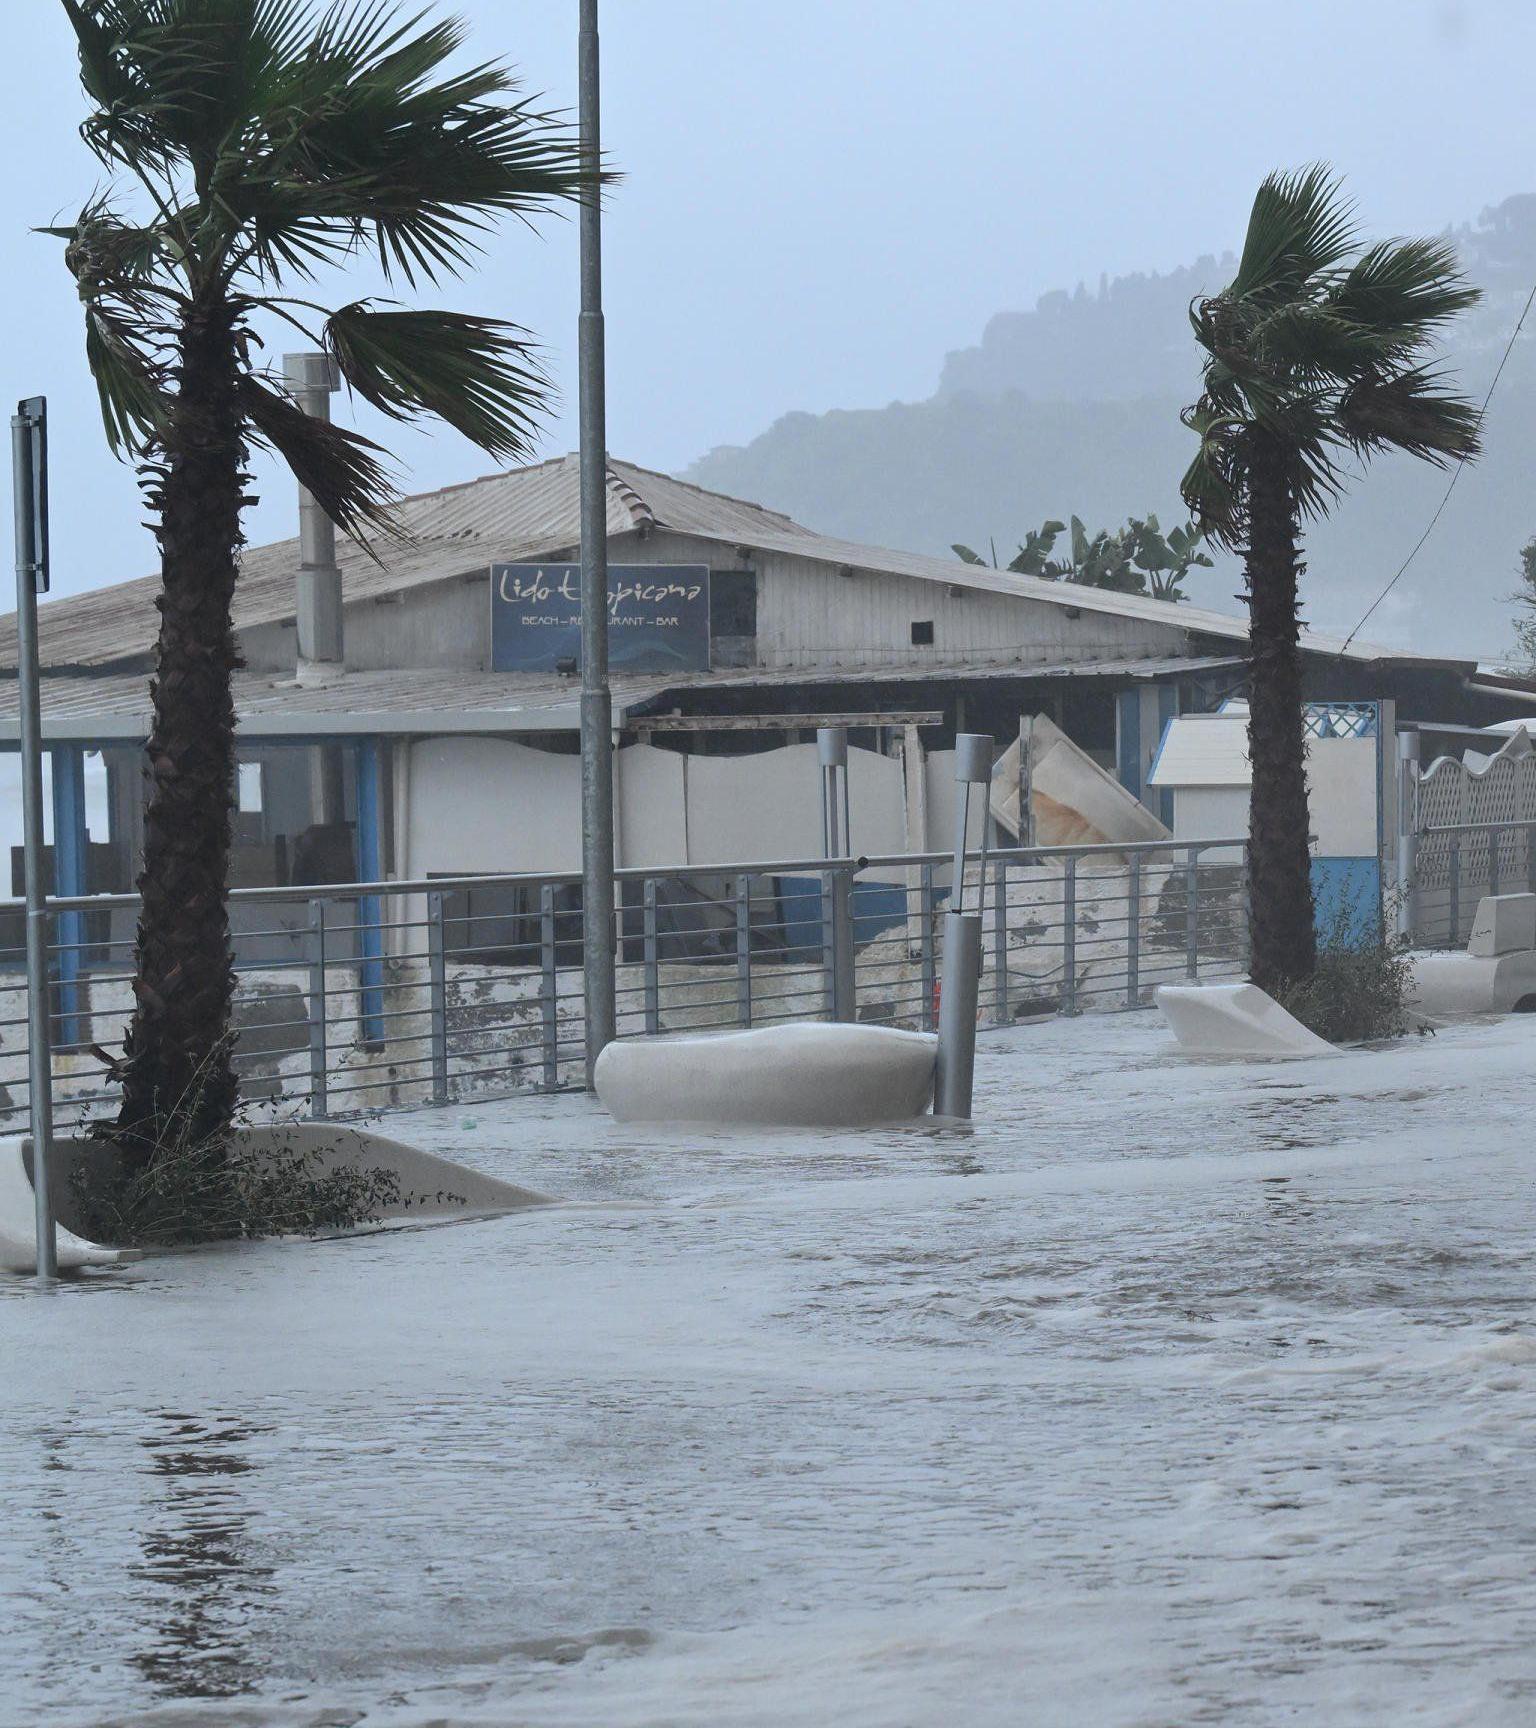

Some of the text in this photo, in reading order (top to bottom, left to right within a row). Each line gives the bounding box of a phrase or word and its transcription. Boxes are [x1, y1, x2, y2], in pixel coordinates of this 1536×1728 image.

[500, 569, 702, 616] Lido topicana
[521, 615, 559, 626] BEACH
[569, 615, 645, 626] REURANT
[656, 616, 680, 626] BAR
